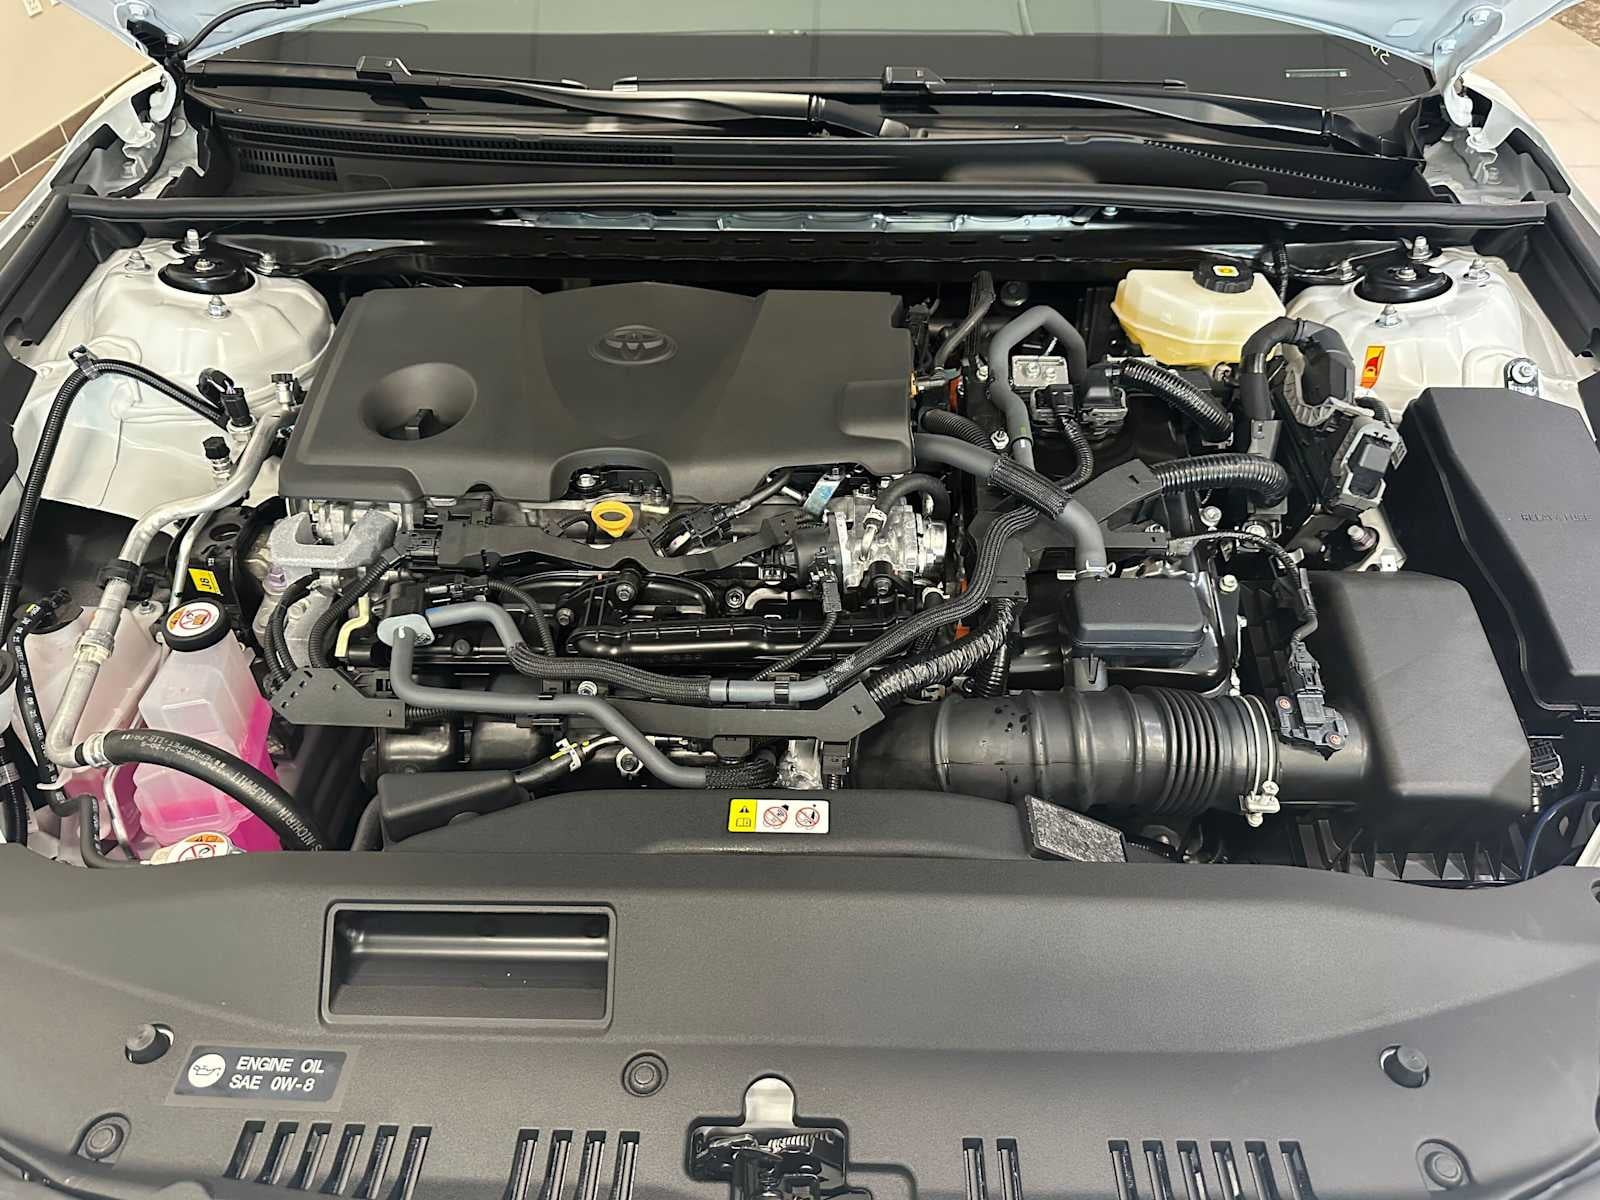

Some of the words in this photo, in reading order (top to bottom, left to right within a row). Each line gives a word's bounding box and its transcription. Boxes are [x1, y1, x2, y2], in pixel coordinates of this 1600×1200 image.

[236, 1056, 294, 1073] ENGINE
[301, 1059, 325, 1074] OIL
[229, 1074, 263, 1090] SAE
[270, 1076, 316, 1092] 0W-8
